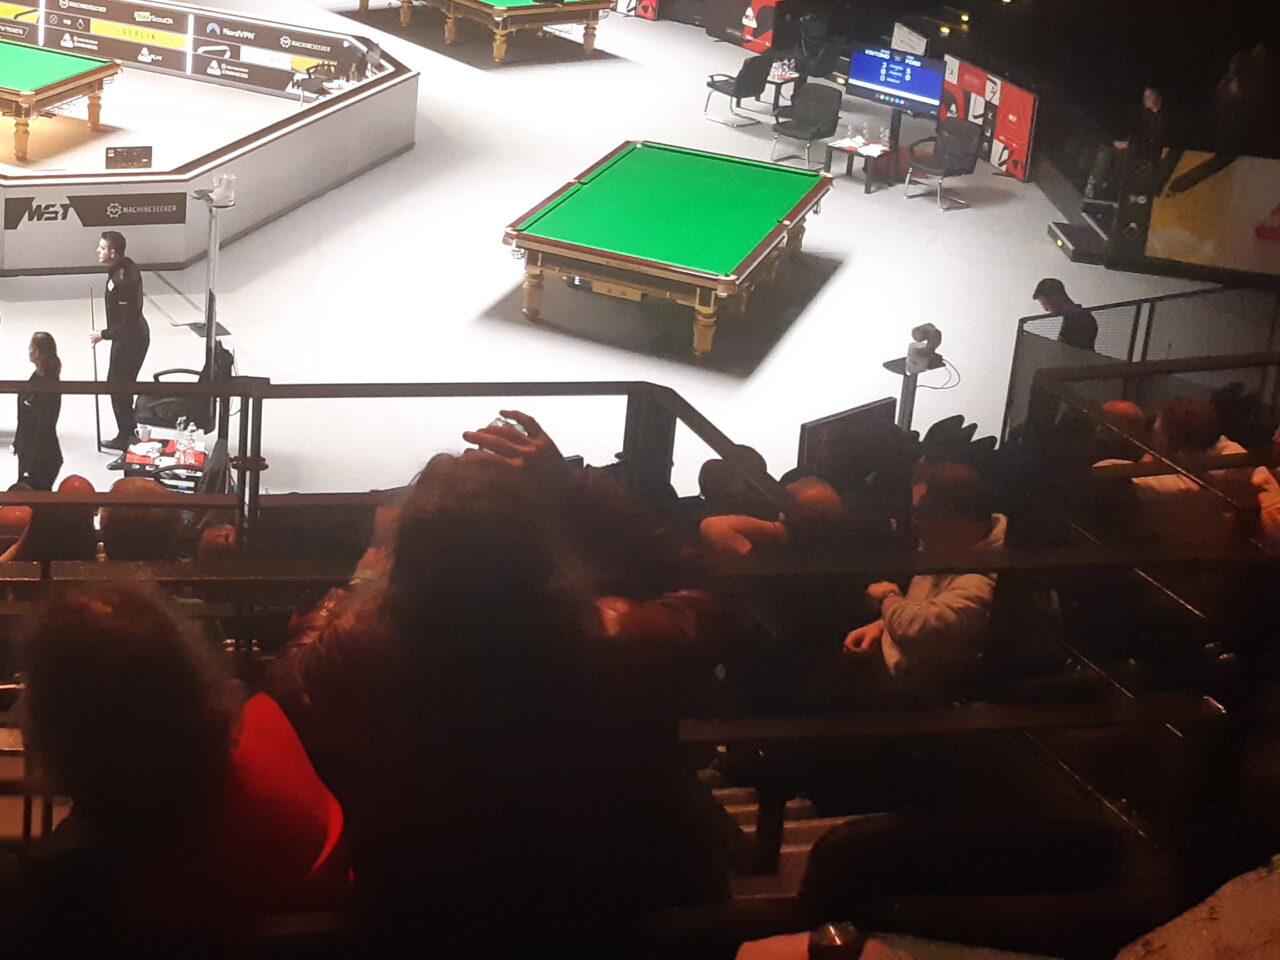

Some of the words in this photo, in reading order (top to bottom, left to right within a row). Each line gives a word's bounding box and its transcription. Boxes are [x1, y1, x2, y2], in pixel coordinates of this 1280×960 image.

[122, 29, 155, 40] BERLIN
[222, 28, 256, 40] NordVPN
[27, 203, 72, 222] WST
[122, 205, 177, 214] MACHINESEEKER
